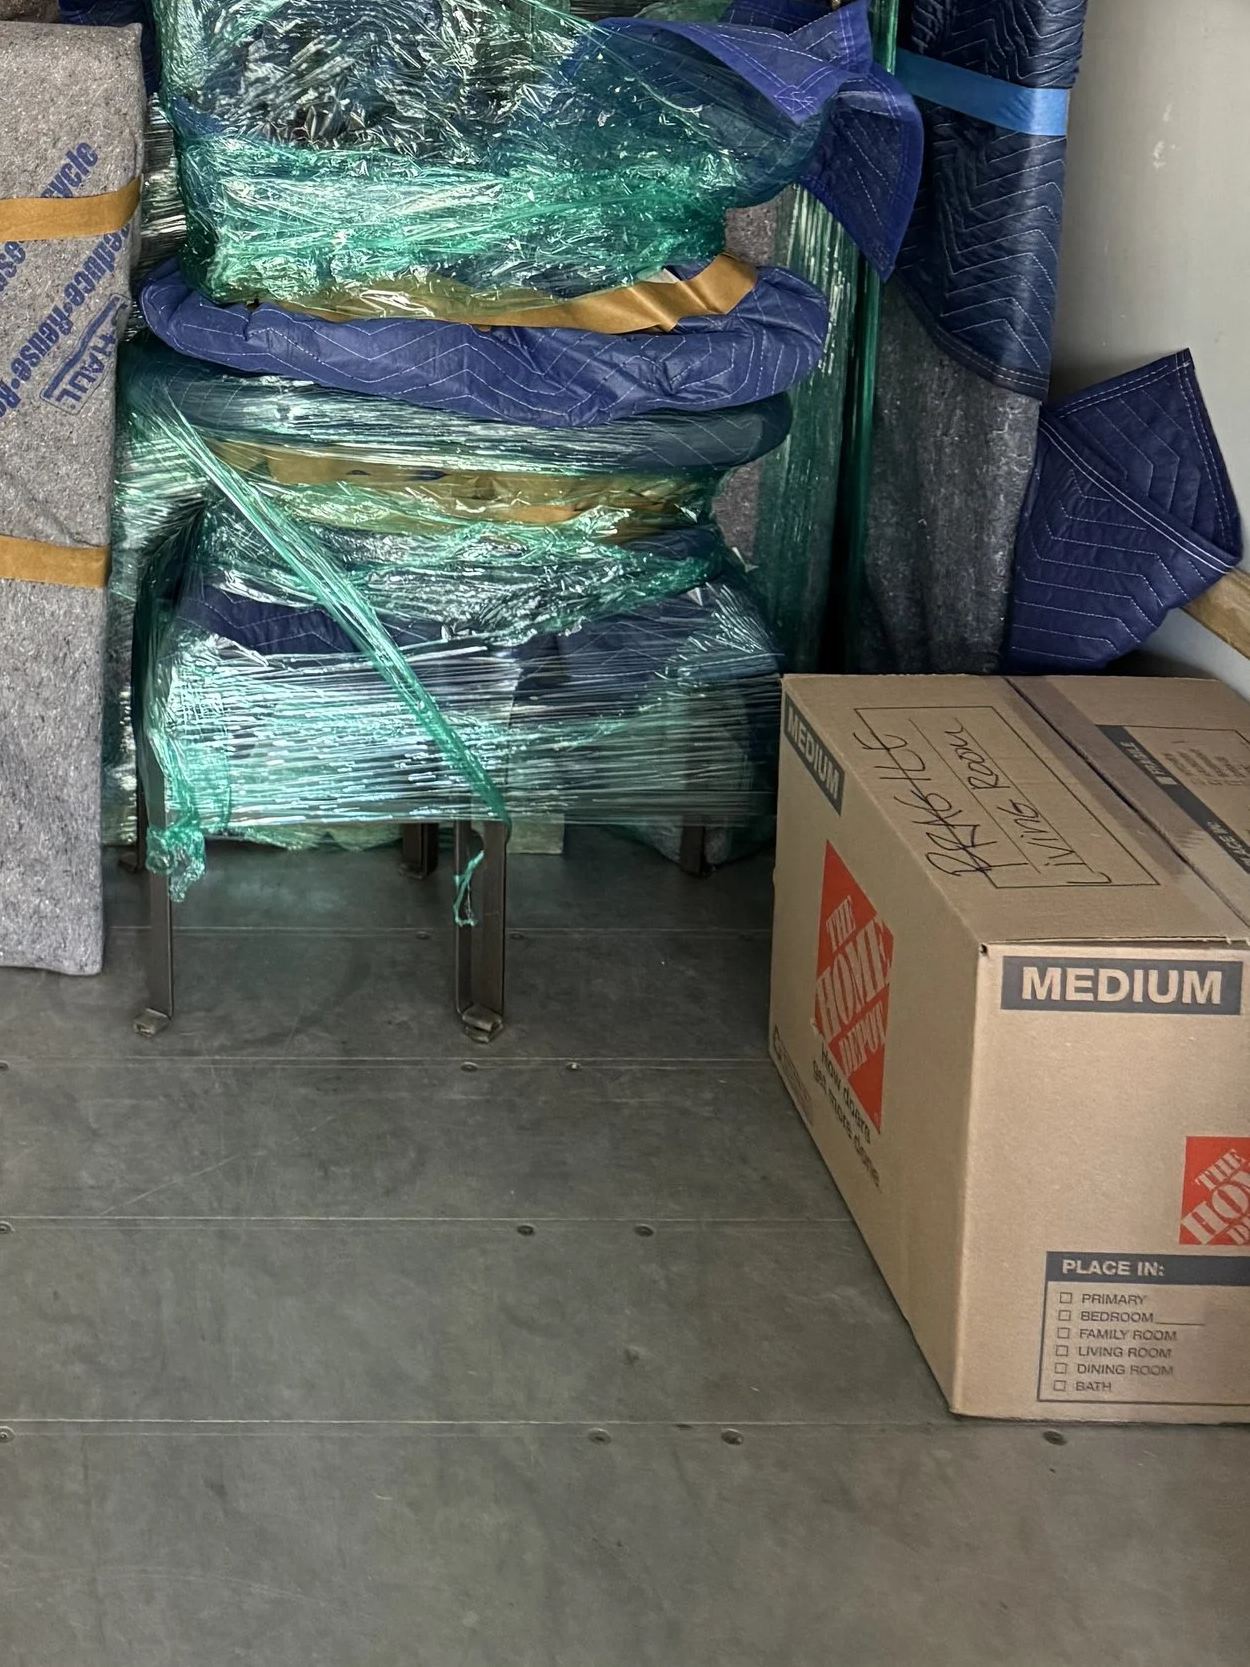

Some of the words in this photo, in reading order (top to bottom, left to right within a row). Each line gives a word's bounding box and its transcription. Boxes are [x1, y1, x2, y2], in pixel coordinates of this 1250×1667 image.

[63, 223, 131, 307] educe
[10, 304, 74, 382] Reuse
[787, 705, 840, 800] MEDIUM
[826, 895, 857, 953] THE
[815, 918, 892, 1045] HOME
[1021, 966, 1223, 1005] MEDIUM
[838, 1001, 886, 1076] DEPOT
[1194, 1148, 1246, 1192] THE
[1180, 1170, 1250, 1246] HO
[1062, 1259, 1131, 1275] PLACE
[1137, 1261, 1165, 1276] IN:
[1080, 1310, 1154, 1323] BEDROOM
[1081, 1293, 1147, 1305] PRIMARY
[1078, 1346, 1123, 1358] LIVING
[1128, 1347, 1172, 1359] ROOM
[1079, 1328, 1131, 1340] FAMILY
[1133, 1329, 1178, 1341] ROOM
[1075, 1380, 1112, 1392] BATH
[1077, 1363, 1125, 1375] DINING
[1130, 1364, 1174, 1376] ROOM
